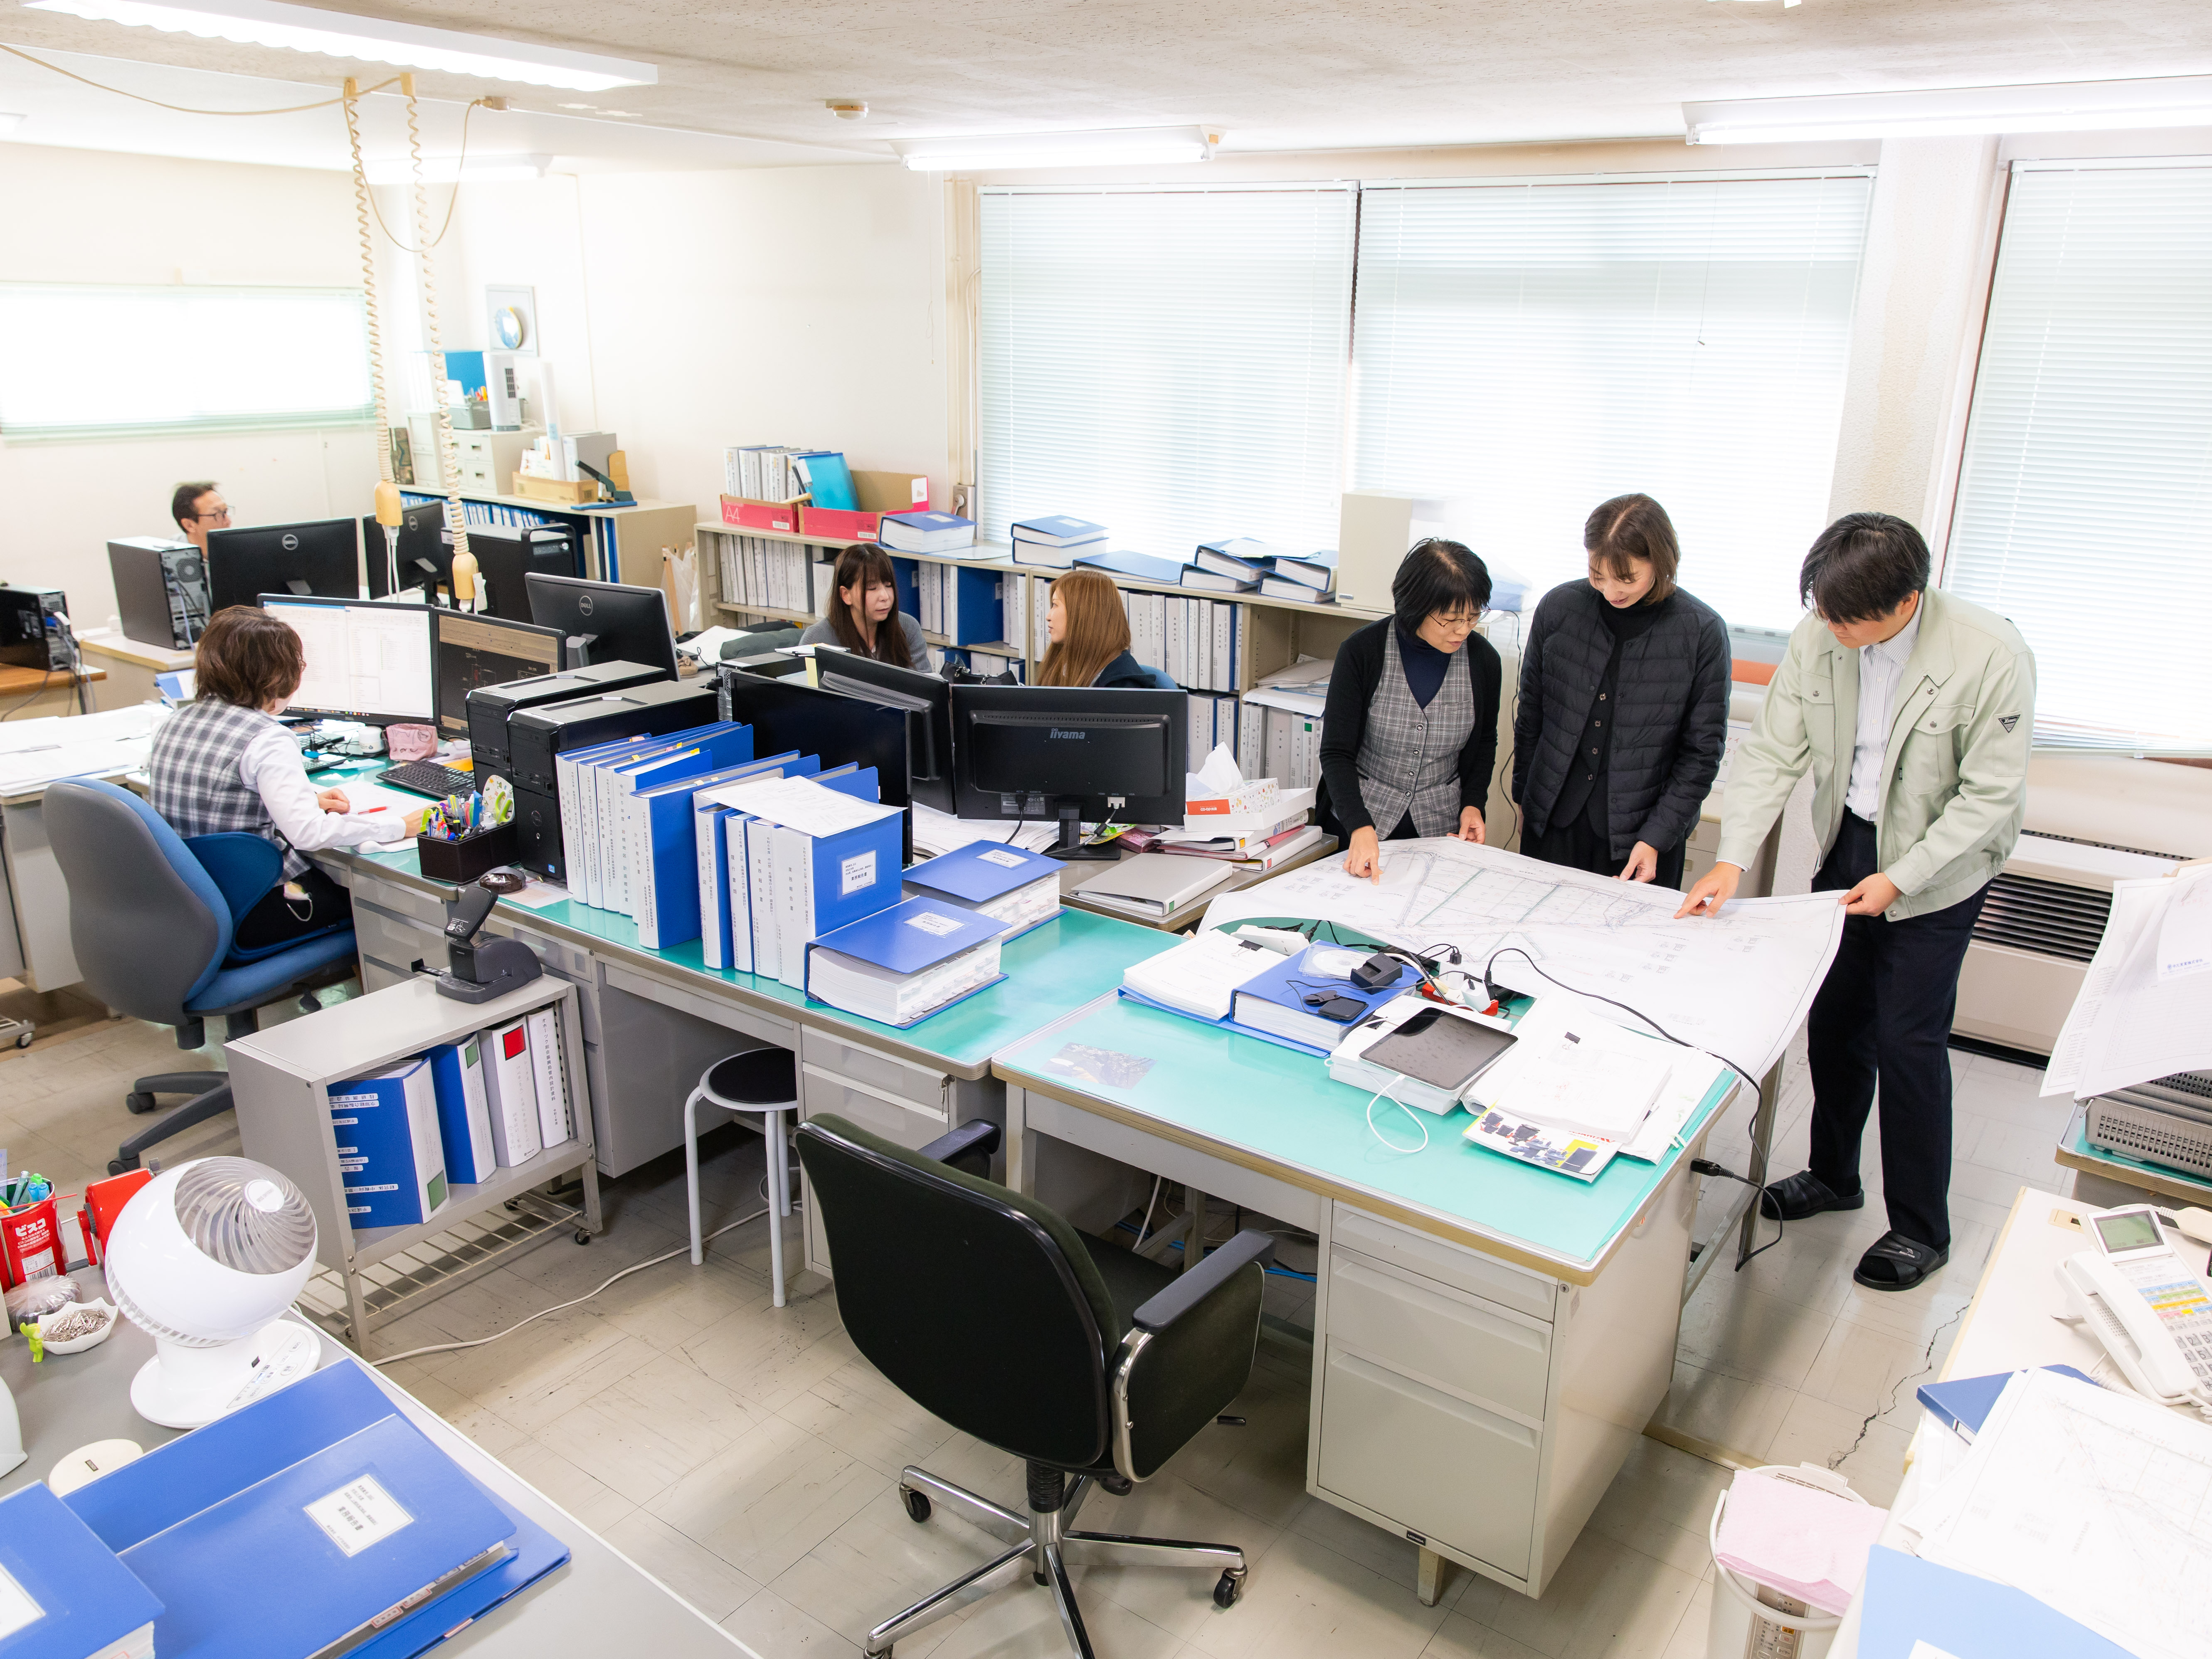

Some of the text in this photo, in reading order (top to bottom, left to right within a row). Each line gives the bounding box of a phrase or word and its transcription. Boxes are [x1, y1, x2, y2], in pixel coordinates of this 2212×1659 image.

[725, 506, 740, 522] A4
[1050, 728, 1085, 739] iiyama
[851, 872, 867, 881] 業務報告書
[542, 1018, 555, 1101] オホーツク総合振興局管内設計資料
[15, 1218, 47, 1237] ビスコ
[2202, 1334, 2210, 1343] 3
[2197, 1351, 2206, 1359] 5
[2192, 1367, 2200, 1376] 7
[338, 1506, 364, 1531] 業務報告書
